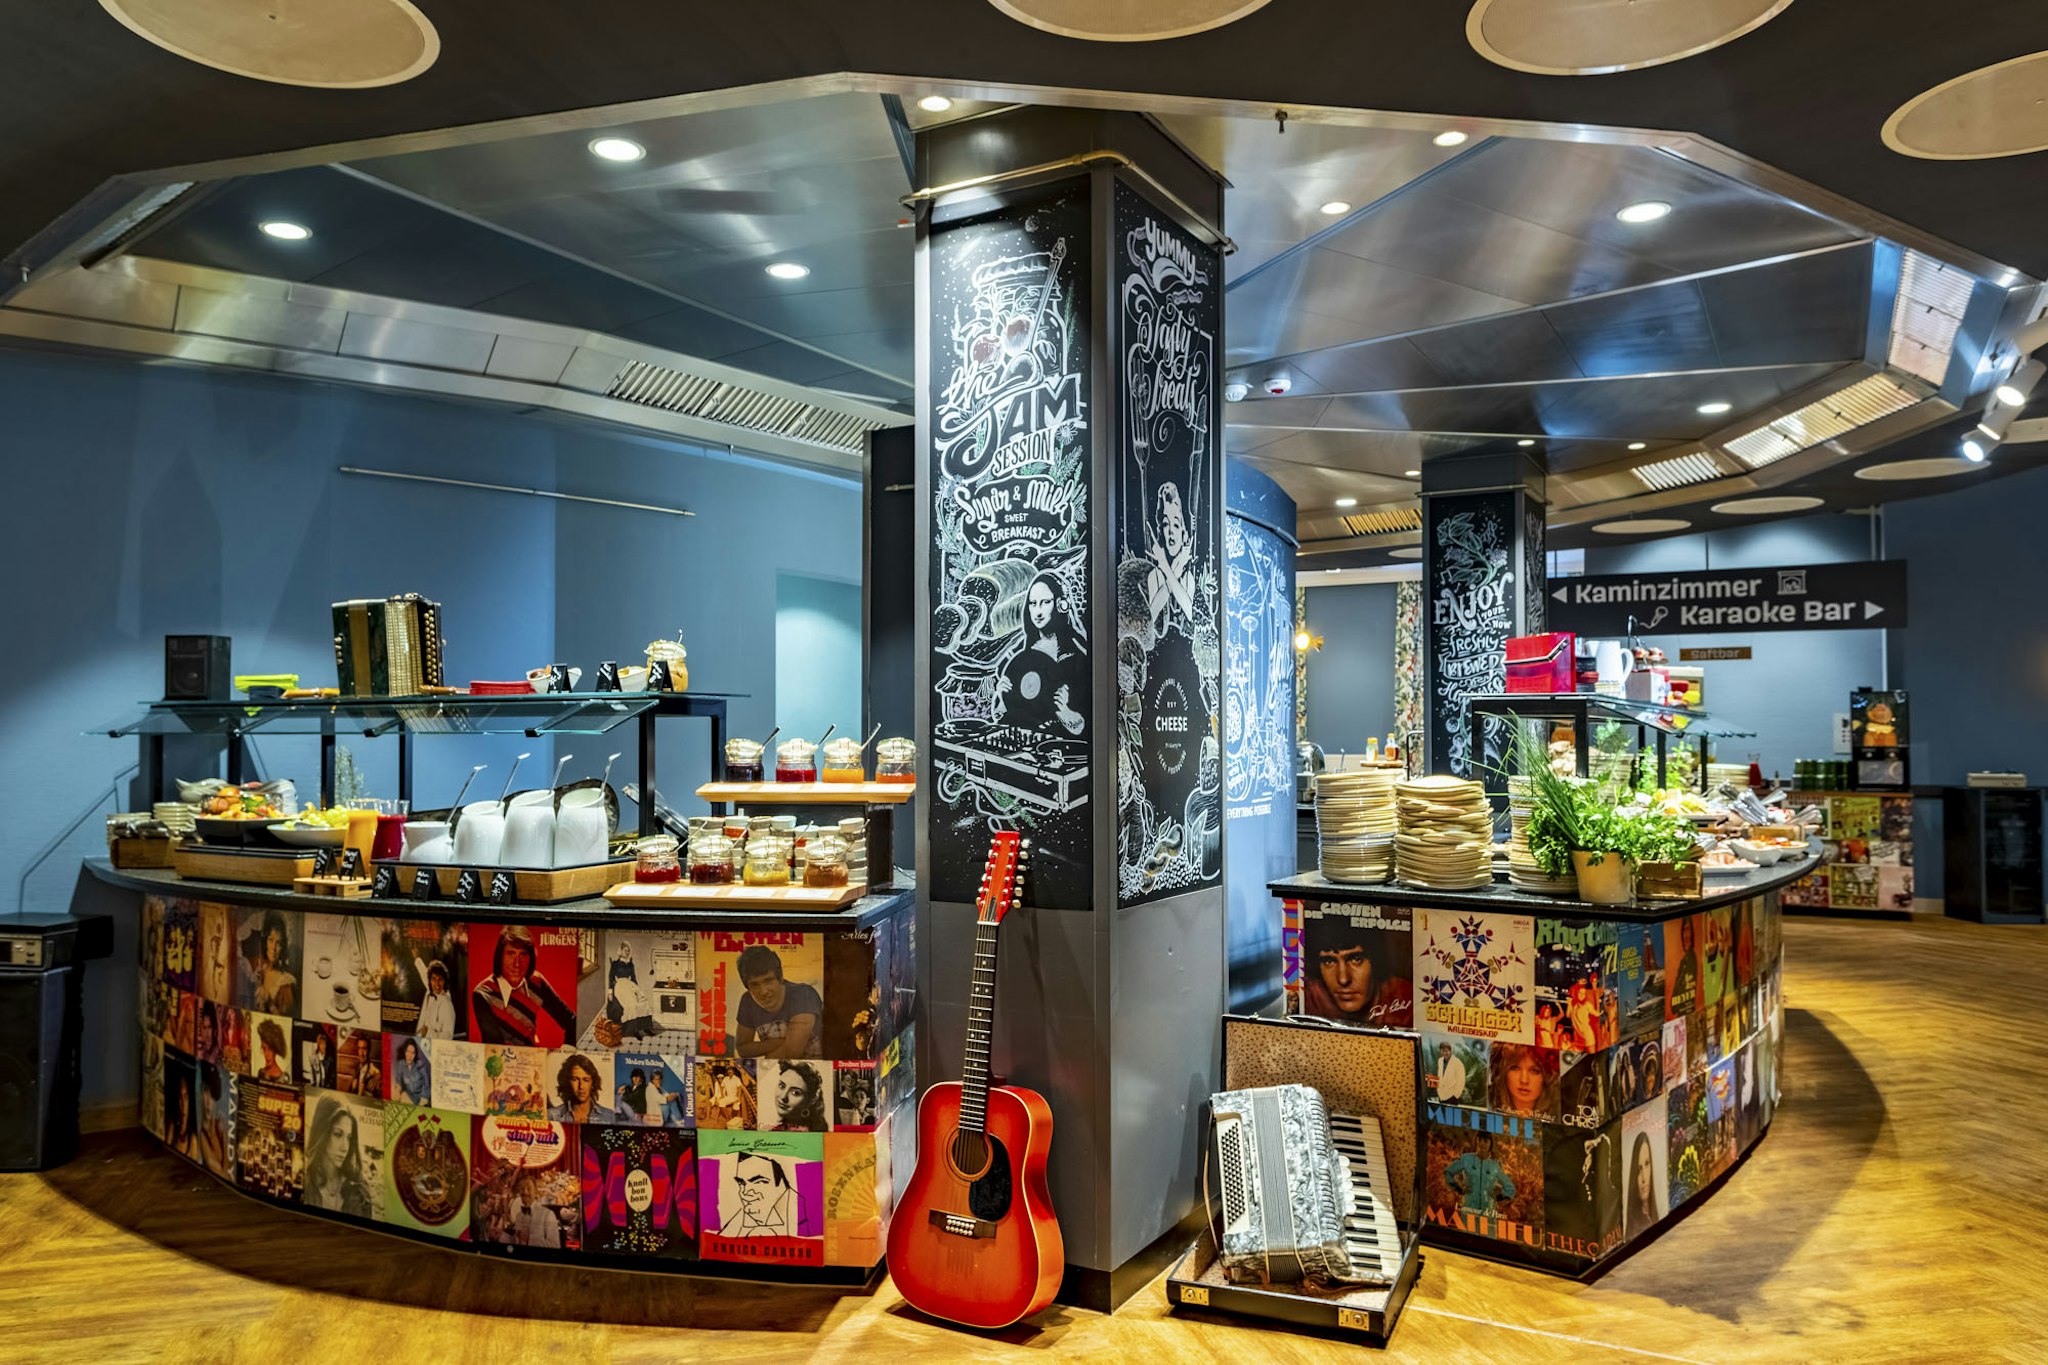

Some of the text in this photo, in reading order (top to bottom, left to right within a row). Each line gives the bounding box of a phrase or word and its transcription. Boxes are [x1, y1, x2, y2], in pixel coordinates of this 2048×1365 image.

[1145, 217, 1196, 287] YUMMY
[935, 373, 1087, 483] JAM
[991, 428, 1052, 477] SESSION
[954, 485, 1013, 533] Sugar
[1004, 512, 1029, 524] SWEET
[991, 525, 1046, 543] BREAKFAST
[1575, 577, 1762, 604] Kaminzimmer
[1680, 600, 1856, 626] Karaoke Bar
[1691, 648, 1740, 660] Saftbar
[1155, 716, 1188, 732] CHEESE
[1350, 917, 1411, 931] ERFOLGE
[539, 932, 577, 946] JÜRGENS
[1425, 1003, 1522, 1033] SCHLAGER
[1447, 1025, 1499, 1038] KALEIDOSKOP
[258, 1095, 300, 1115] SUPER
[227, 1072, 238, 1183] MANDY
[283, 1115, 301, 1131] 20
[631, 1186, 646, 1195] bon
[713, 1242, 813, 1259] ENRICO CARUSO
[1547, 1231, 1600, 1257] THEO
